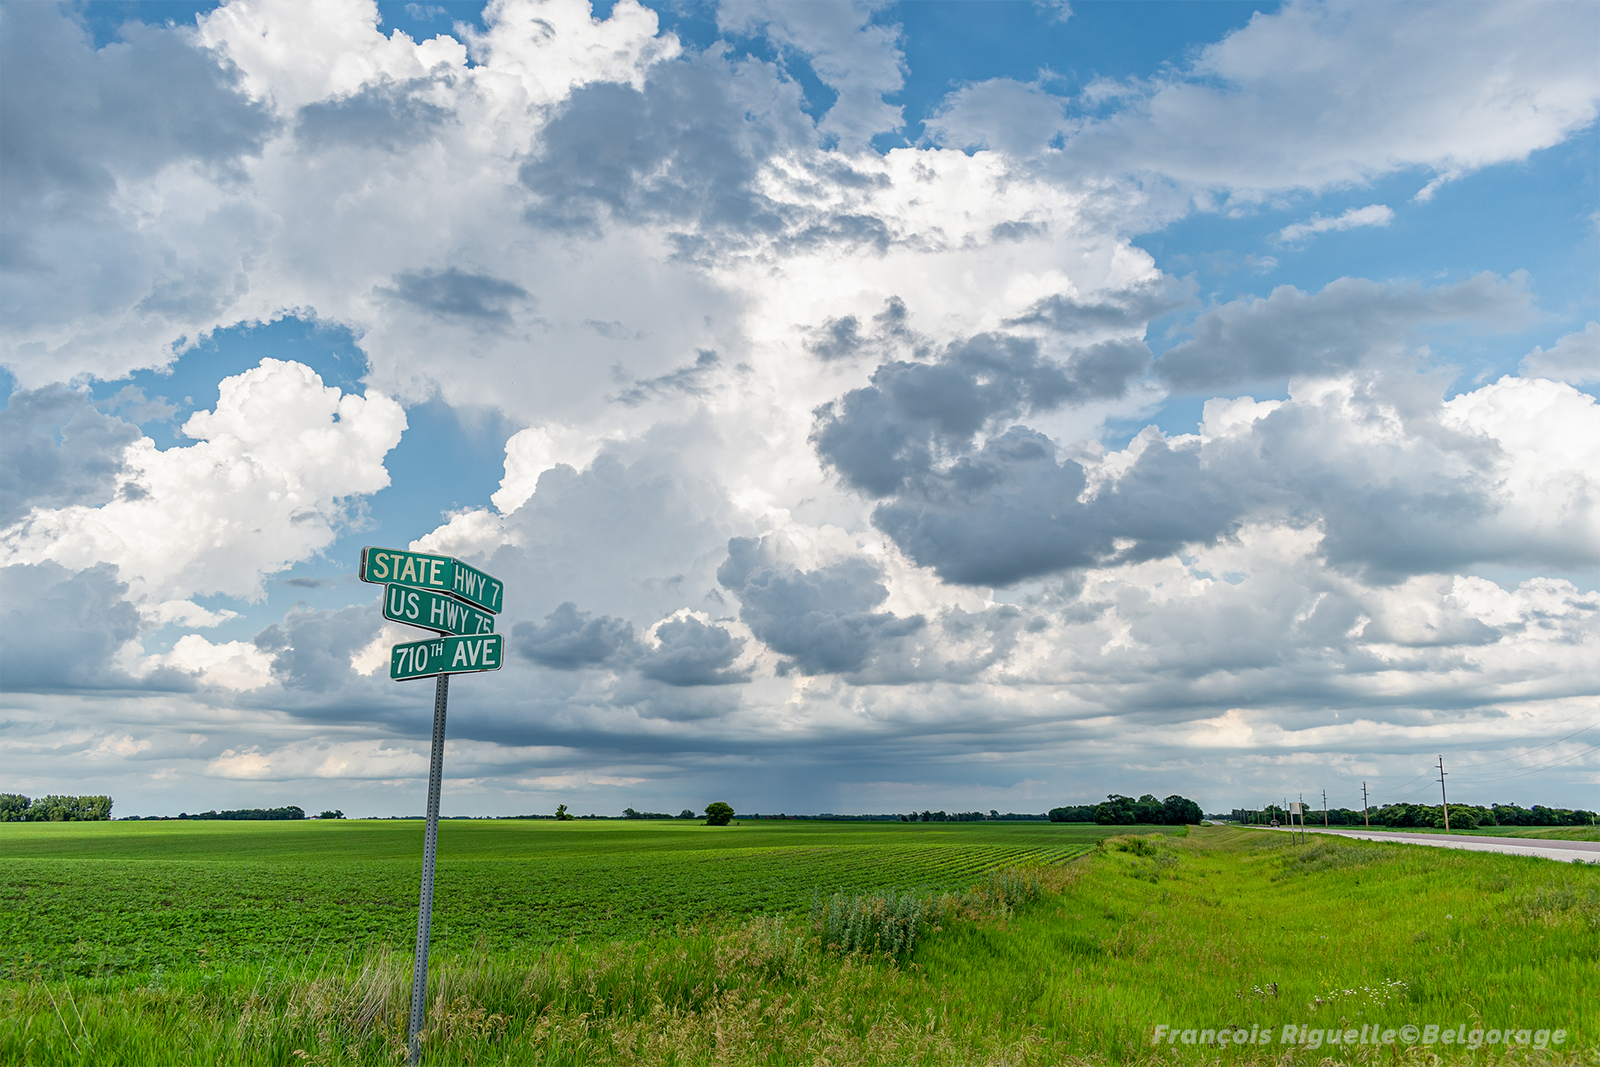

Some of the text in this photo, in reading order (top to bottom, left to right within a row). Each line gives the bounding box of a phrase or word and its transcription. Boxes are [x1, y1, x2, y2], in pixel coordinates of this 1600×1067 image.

[373, 553, 500, 607] STATE HWY 7
[390, 588, 492, 635] US HWY 75
[451, 639, 497, 667] AVE
